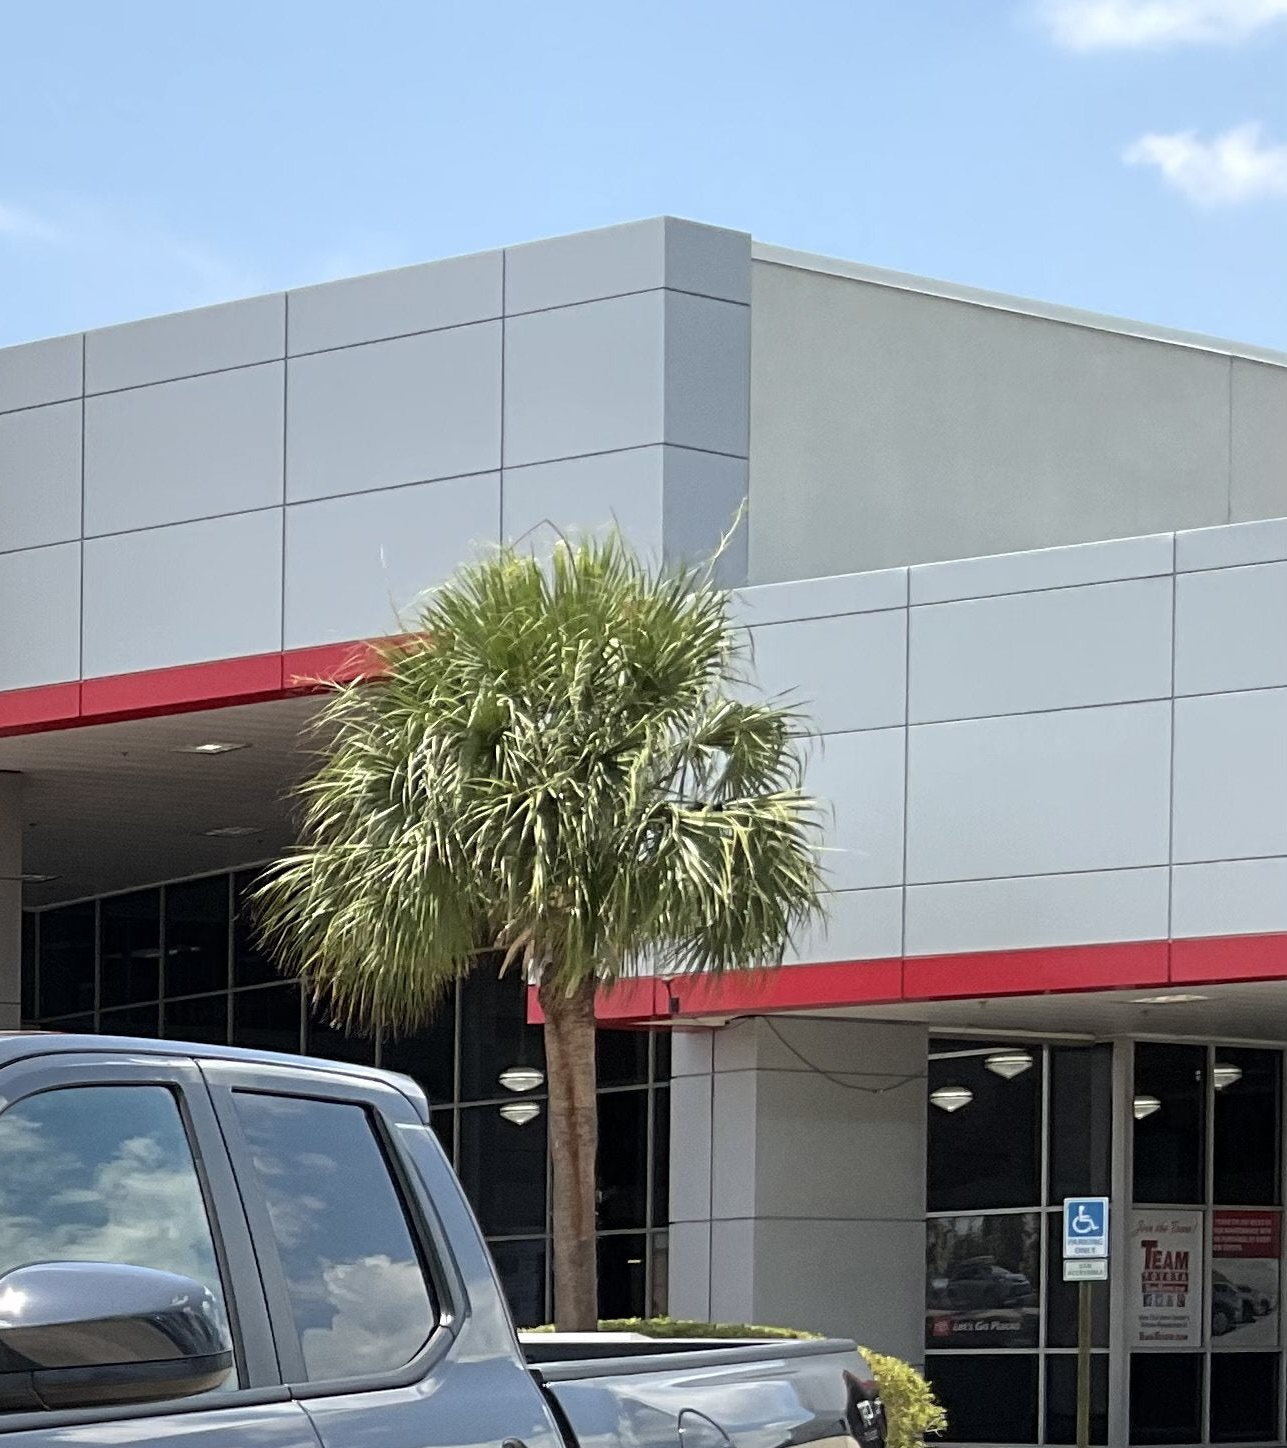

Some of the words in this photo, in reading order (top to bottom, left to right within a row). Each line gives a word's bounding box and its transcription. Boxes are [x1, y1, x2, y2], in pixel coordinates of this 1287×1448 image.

[1067, 1238, 1103, 1246] PARKING
[952, 1321, 973, 1331] Let's
[975, 1321, 989, 1331] Go
